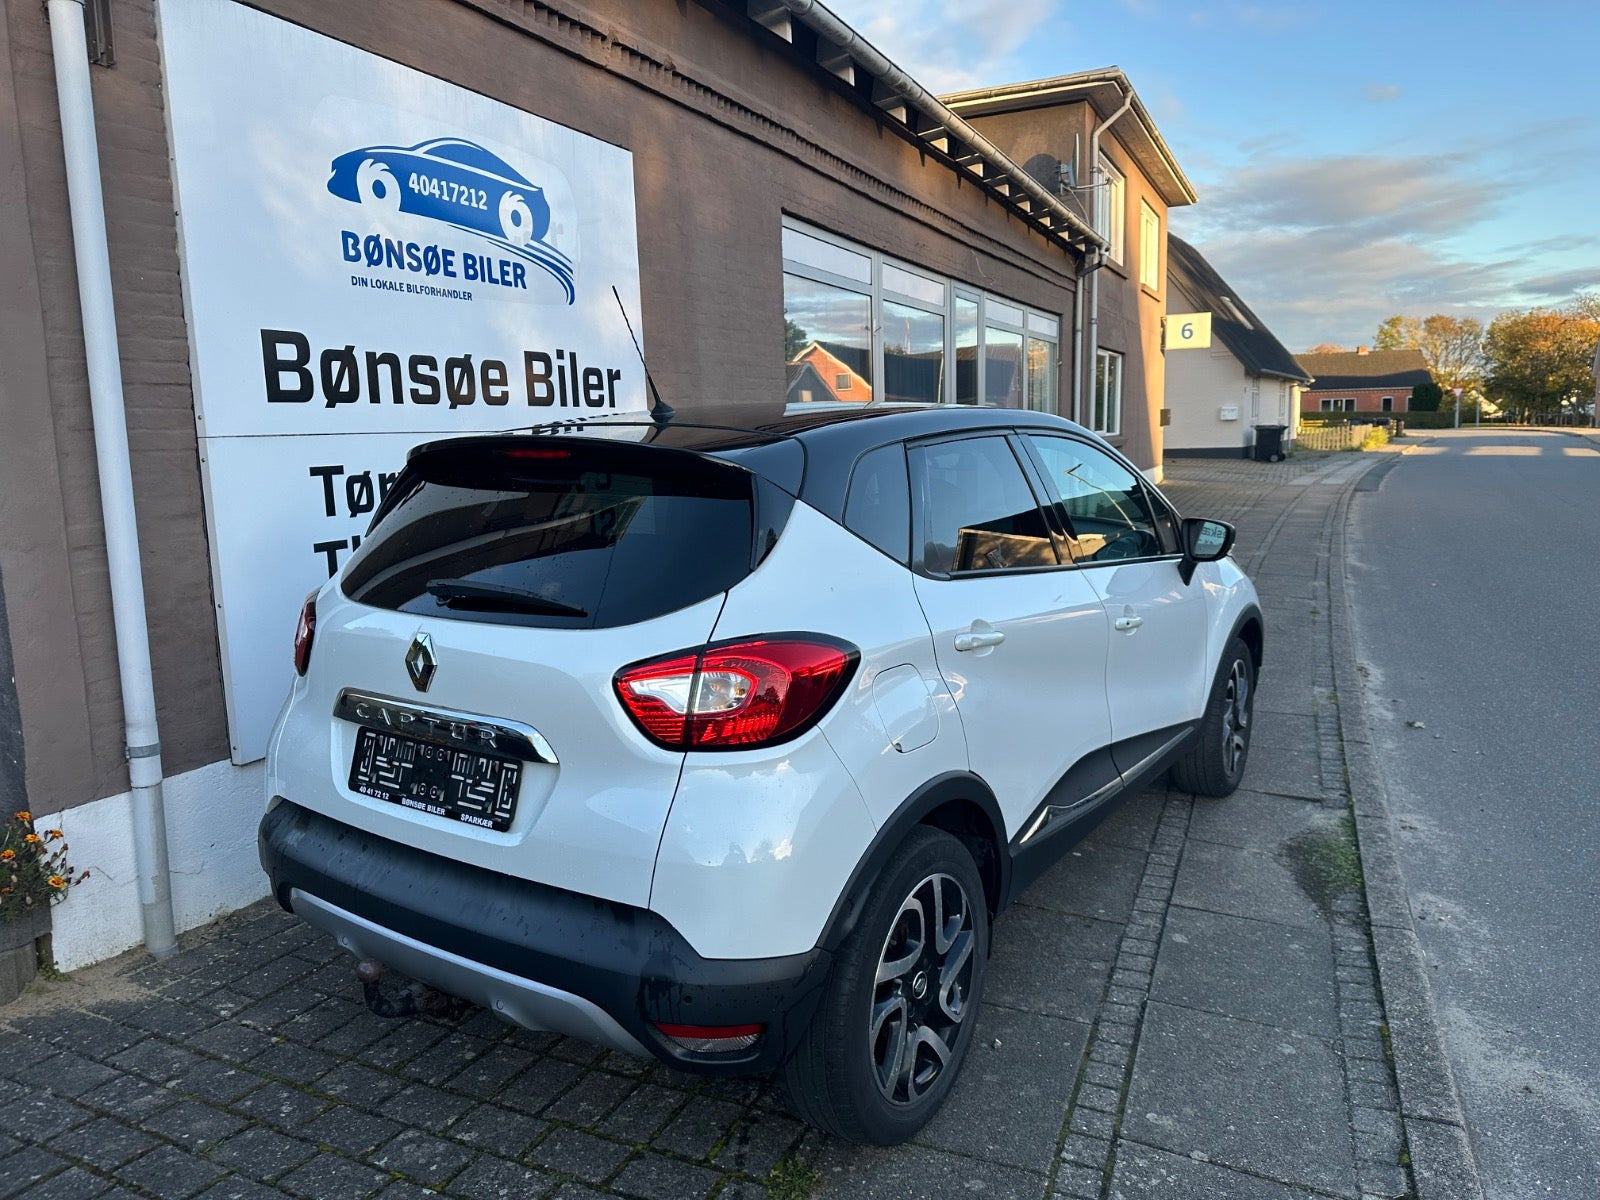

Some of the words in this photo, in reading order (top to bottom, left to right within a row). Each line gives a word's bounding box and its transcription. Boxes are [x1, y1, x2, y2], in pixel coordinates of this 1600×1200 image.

[408, 171, 488, 210] 40417212
[341, 230, 457, 278] BØNSØE
[463, 252, 527, 289] BILER
[350, 275, 368, 288] DIN
[370, 278, 404, 292] LOKALE
[406, 283, 473, 302] BILFORHANDLER
[1181, 322, 1194, 340] 6
[260, 328, 509, 410] Bønsøe
[524, 349, 621, 408] Biler
[309, 465, 400, 518] Tør
[356, 702, 497, 748] CAPTUR
[427, 804, 446, 816] BILER
[460, 813, 493, 828] SPARKÆR
